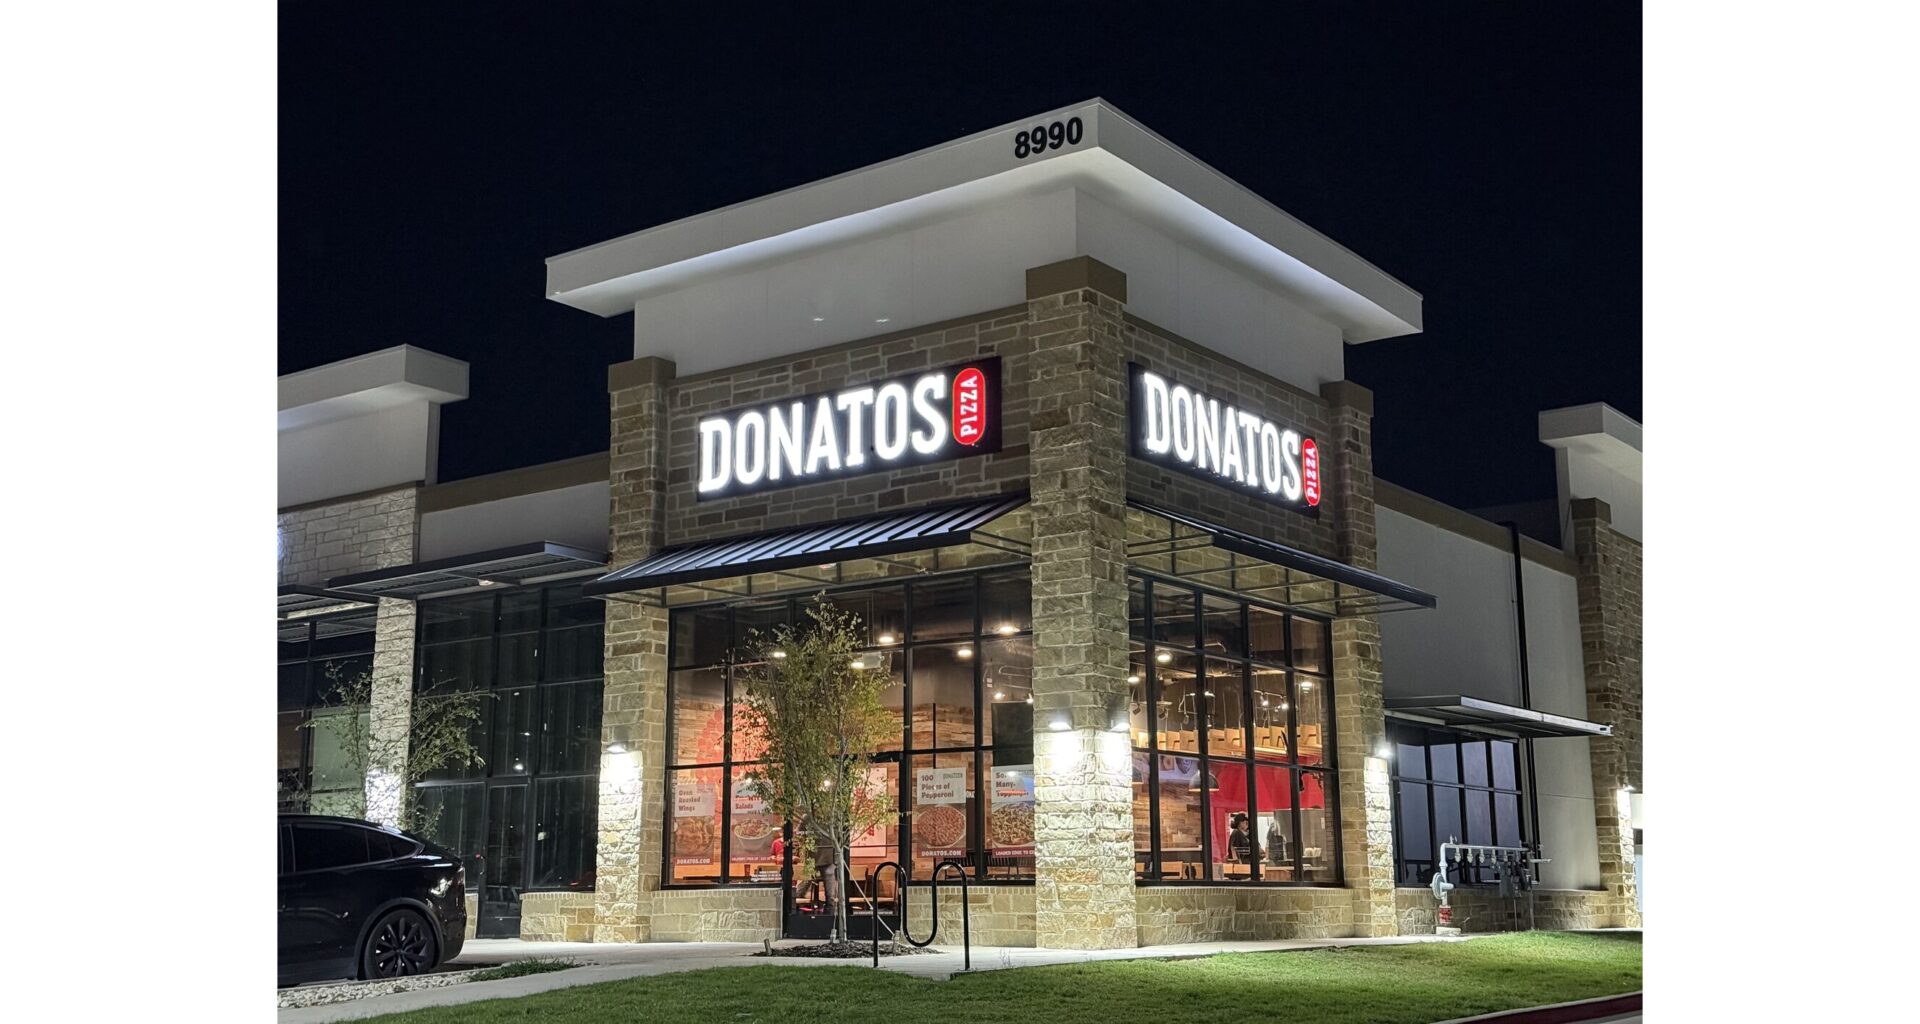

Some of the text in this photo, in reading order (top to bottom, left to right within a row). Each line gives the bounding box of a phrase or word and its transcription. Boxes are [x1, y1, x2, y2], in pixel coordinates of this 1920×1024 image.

[1015, 116, 1083, 159] 8990
[698, 373, 948, 493] DONATOS
[960, 376, 978, 437] PIZZA
[1143, 372, 1302, 501] DONATOS
[1305, 447, 1318, 499] PIZZA
[921, 790, 954, 799] Pepperoni
